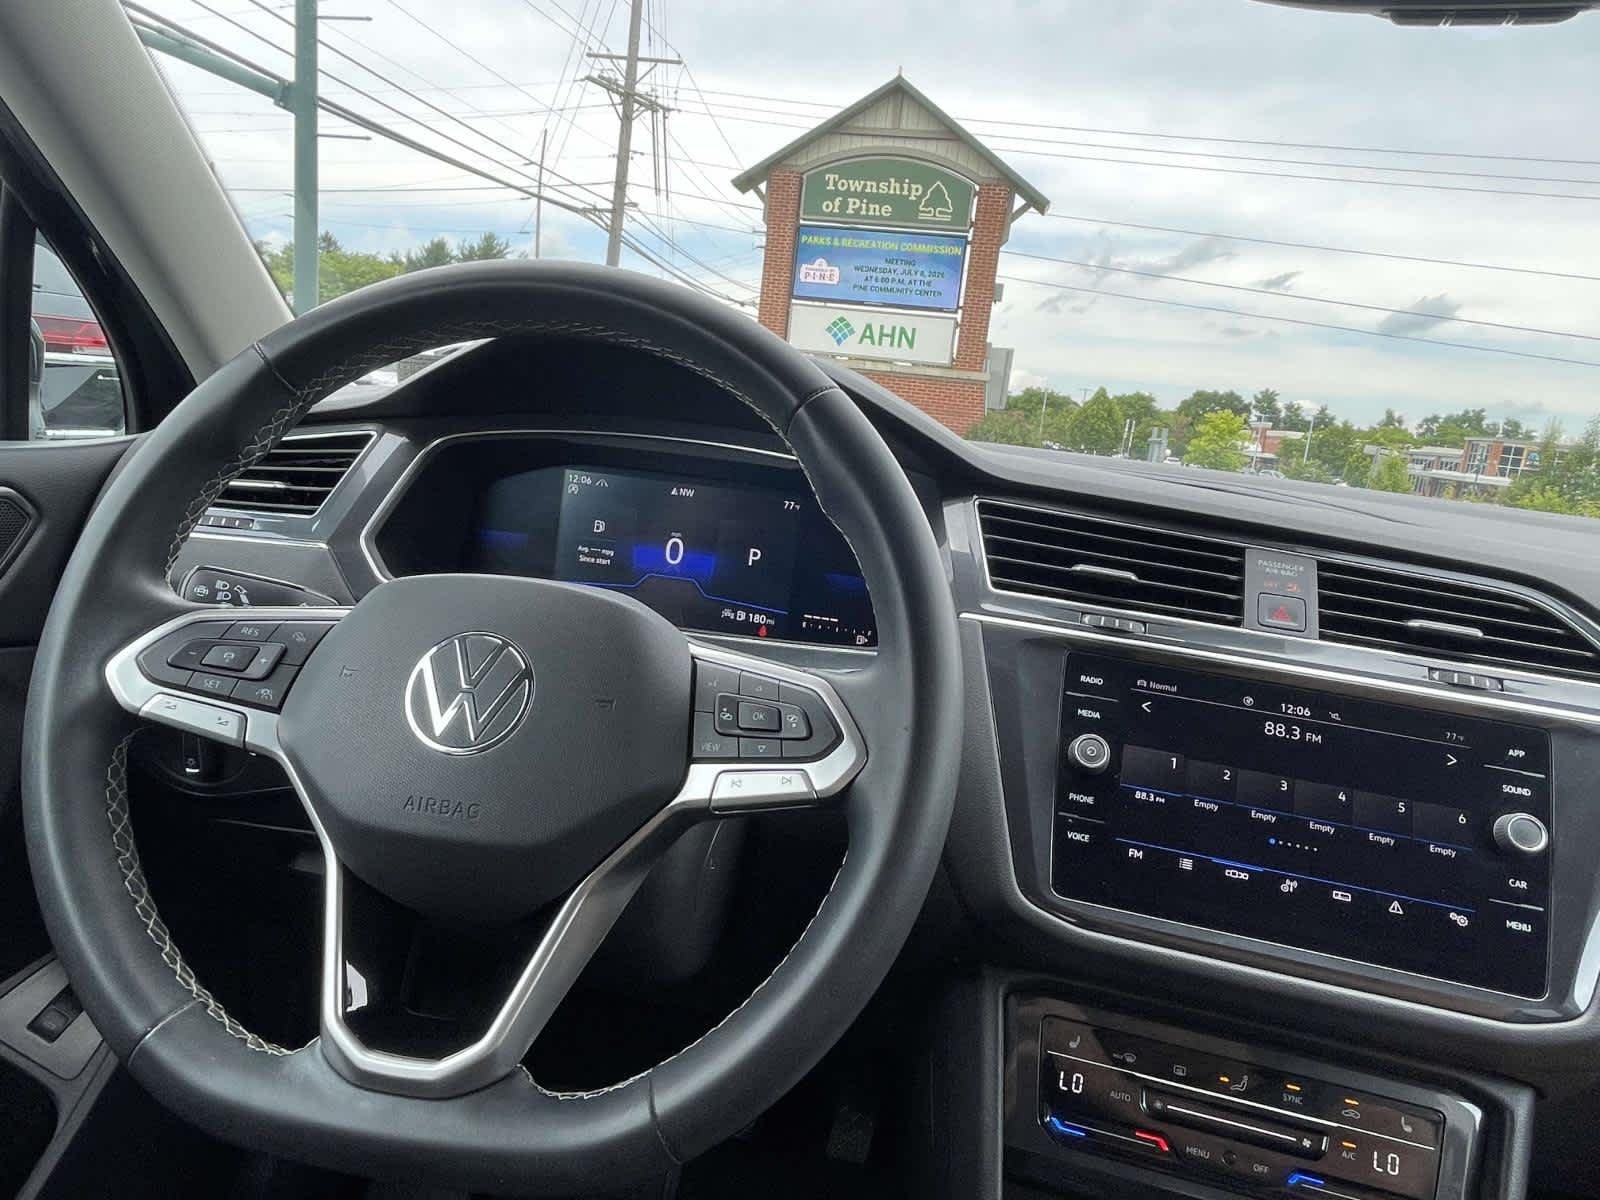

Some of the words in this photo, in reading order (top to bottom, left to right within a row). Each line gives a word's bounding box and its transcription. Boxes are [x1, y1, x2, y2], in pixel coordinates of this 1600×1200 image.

[825, 174, 922, 200] Township
[822, 197, 842, 213] of
[846, 198, 892, 216] Pine
[801, 235, 831, 246] PARKS
[832, 237, 840, 247] &
[842, 238, 898, 250] RECREATION
[902, 242, 962, 255] COMMISSION
[884, 257, 916, 266] MEETING
[854, 264, 898, 275] WEDNESDAY,
[899, 269, 918, 277] JULY
[852, 284, 867, 292] PINE
[870, 285, 914, 296] COMMUNITY
[915, 288, 942, 298] CENTER
[858, 323, 917, 349] AHN
[568, 474, 592, 485] 12:06
[679, 488, 695, 497] NW
[665, 538, 684, 564] 0
[748, 548, 761, 566] P
[579, 554, 595, 563] Since
[596, 557, 610, 565] start
[1257, 559, 1304, 572] PASSENGER
[748, 613, 767, 625] 180
[240, 626, 260, 637] RES
[203, 678, 221, 689] SET
[1080, 674, 1104, 686] RADIO
[1149, 680, 1177, 693] Normal
[1077, 708, 1101, 720] MEDIA
[1280, 702, 1311, 717] 12:06
[752, 712, 766, 721] OK
[1264, 721, 1301, 740] 88.3
[1306, 732, 1322, 745] FM
[701, 743, 721, 752] VIEW
[1508, 748, 1526, 759] APP
[1170, 757, 1178, 769] 1
[1223, 770, 1231, 781] 2
[1280, 780, 1288, 791] 3
[1502, 784, 1532, 797] SOUND
[1068, 792, 1095, 805] PHONE
[1135, 790, 1155, 802] 88.3
[1155, 796, 1166, 804] FM
[1338, 791, 1346, 802] 4
[403, 795, 480, 819] AIRBAG
[1194, 799, 1219, 812] Empty
[1398, 802, 1406, 813] 5
[1251, 810, 1277, 823] Empty
[1458, 813, 1466, 824] 6
[1309, 821, 1335, 835] Empty
[1067, 831, 1090, 843] VOICE
[1368, 833, 1395, 846] Empty
[1128, 848, 1143, 860] FM
[1430, 844, 1457, 858] Empty
[1508, 878, 1529, 890] CAR
[1506, 920, 1532, 933] MENU
[1058, 1070, 1084, 1094] LO
[1110, 1089, 1131, 1102] AUTO
[1282, 1093, 1303, 1106] SYNC
[1186, 1145, 1210, 1160] MENU
[1253, 1163, 1269, 1174] OFF
[1373, 1150, 1400, 1176] LO
